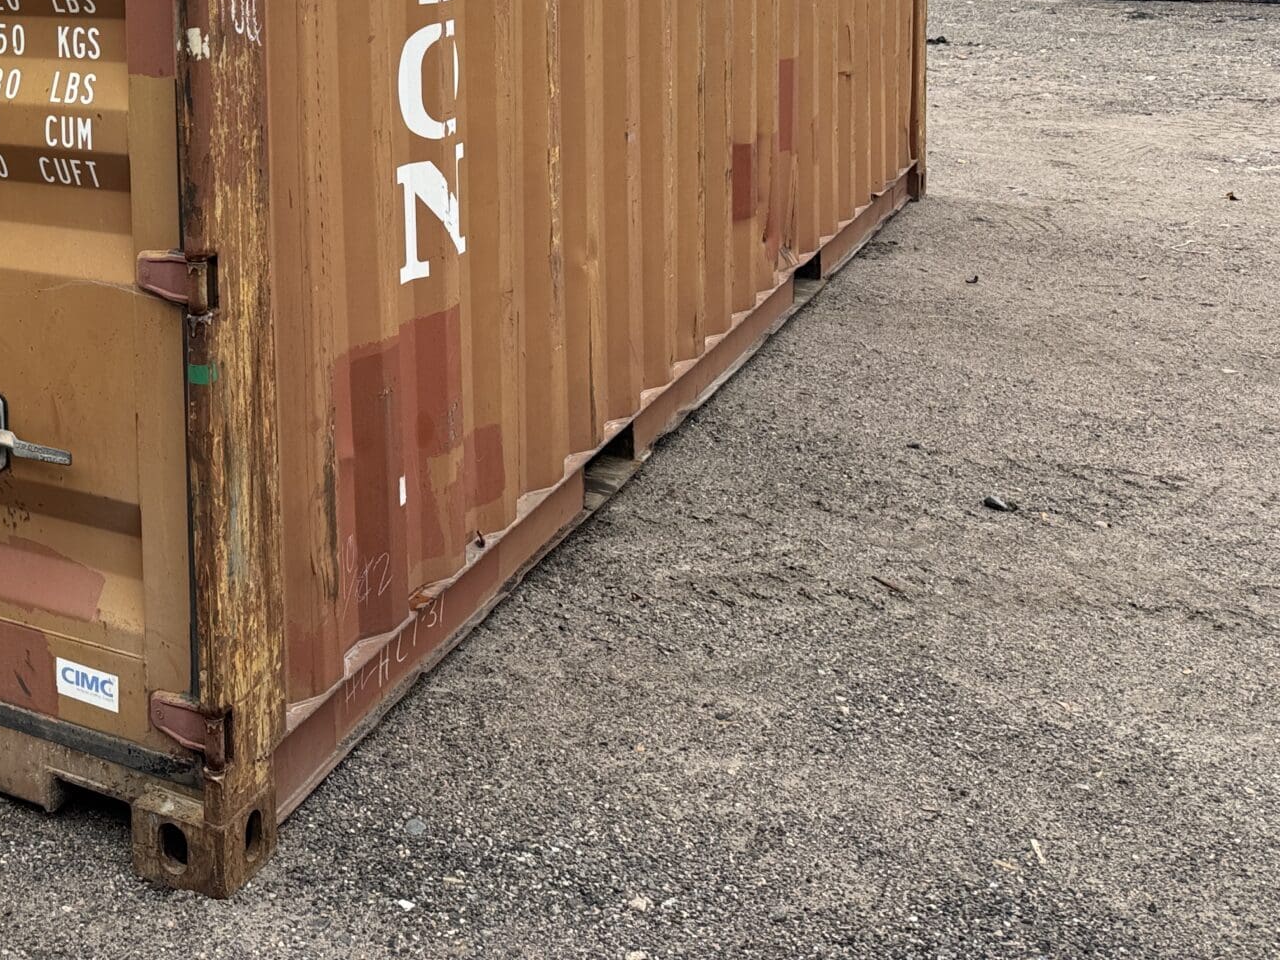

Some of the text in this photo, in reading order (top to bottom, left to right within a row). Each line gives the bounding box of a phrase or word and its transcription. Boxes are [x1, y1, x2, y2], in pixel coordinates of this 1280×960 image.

[57, 25, 102, 60] KGS
[49, 71, 97, 105] LBS
[45, 115, 93, 150] CUM
[38, 156, 100, 188] CUFT
[61, 666, 114, 698] CIMC
